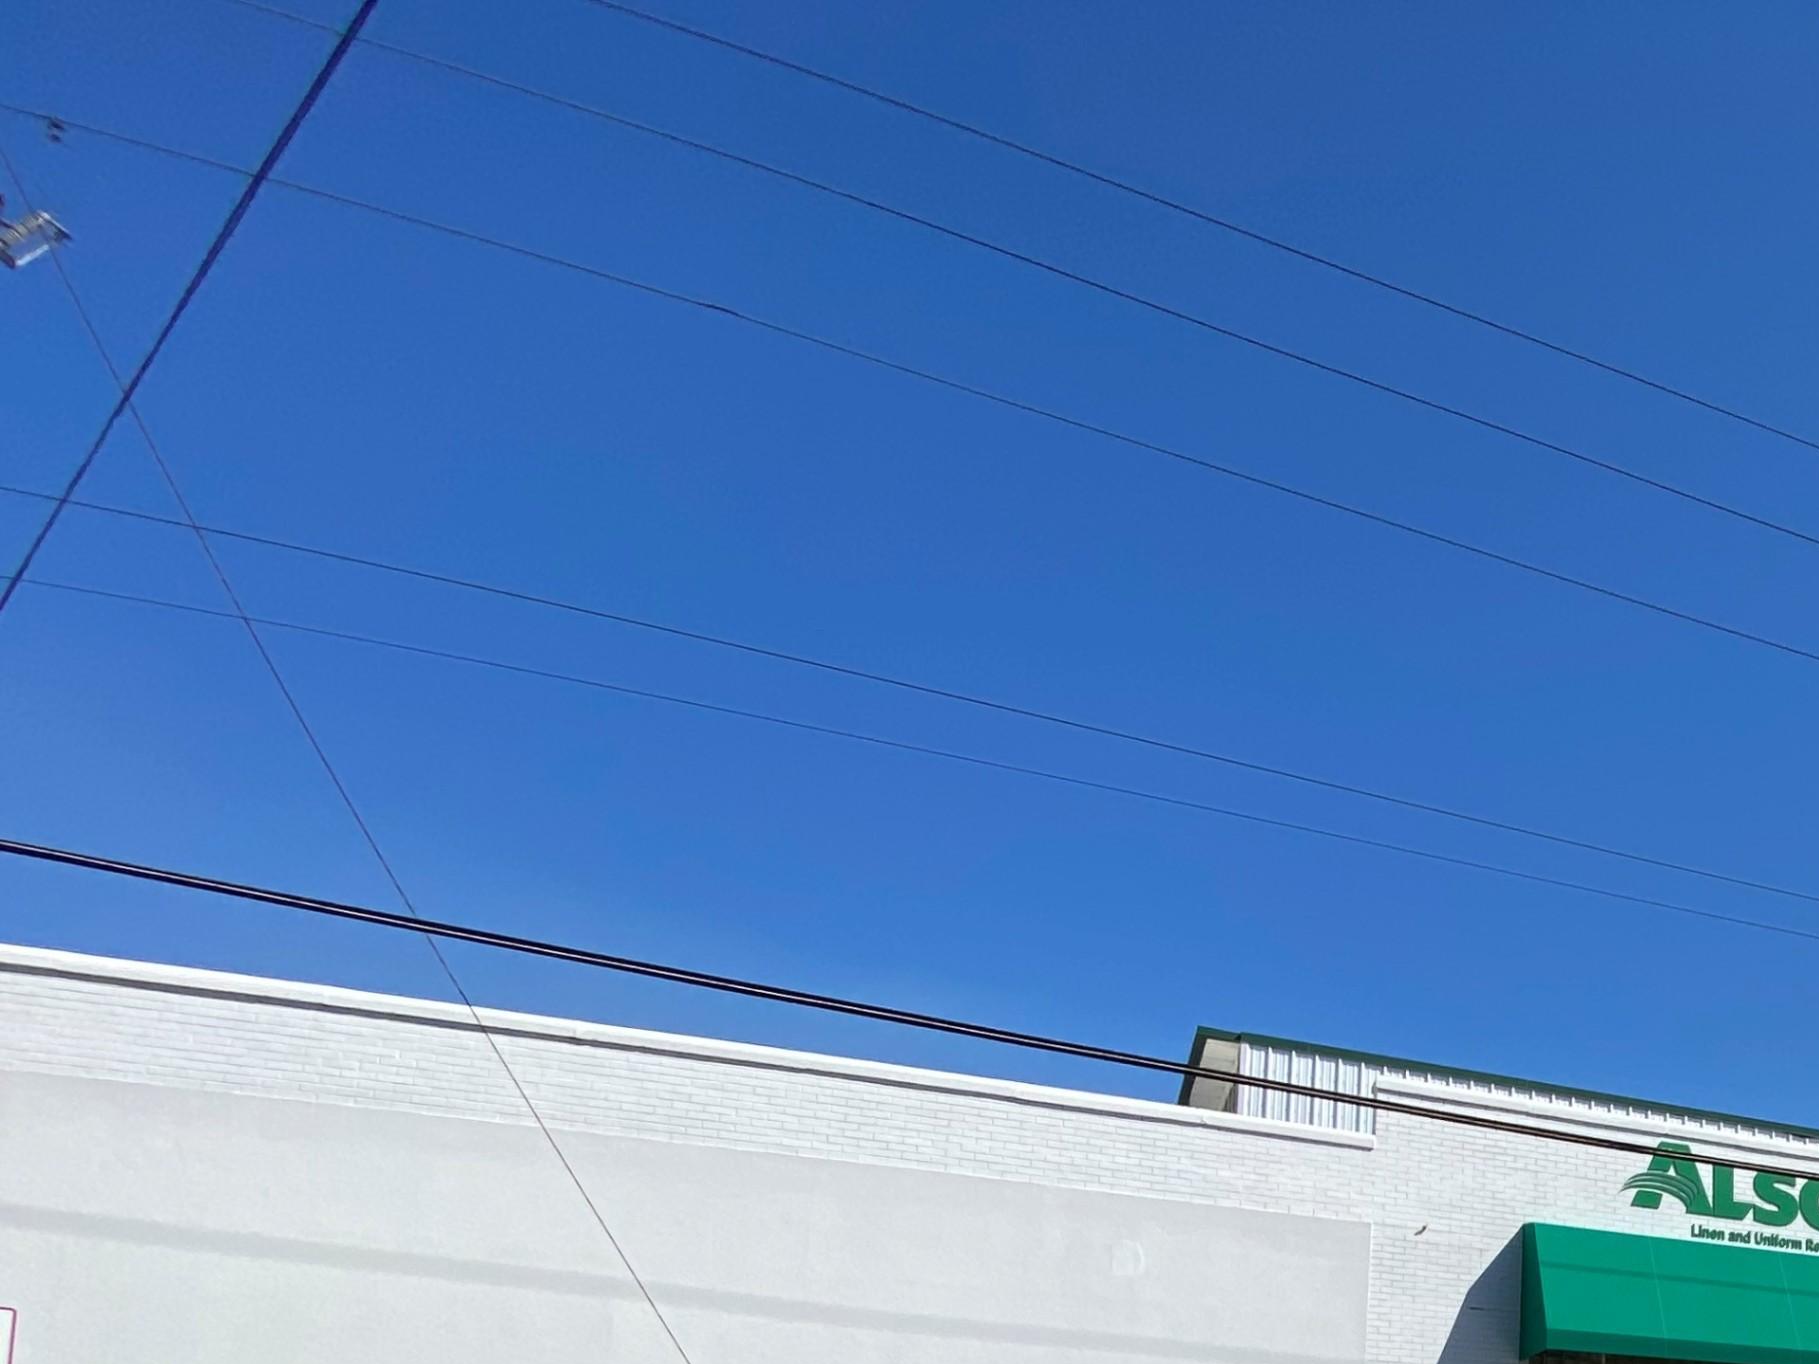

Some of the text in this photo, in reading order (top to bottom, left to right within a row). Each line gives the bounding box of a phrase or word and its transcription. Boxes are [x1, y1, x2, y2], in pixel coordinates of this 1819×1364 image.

[1691, 1224, 1725, 1241] Linen
[1728, 1230, 1751, 1244] and
[1754, 1232, 1802, 1251] Uniform
